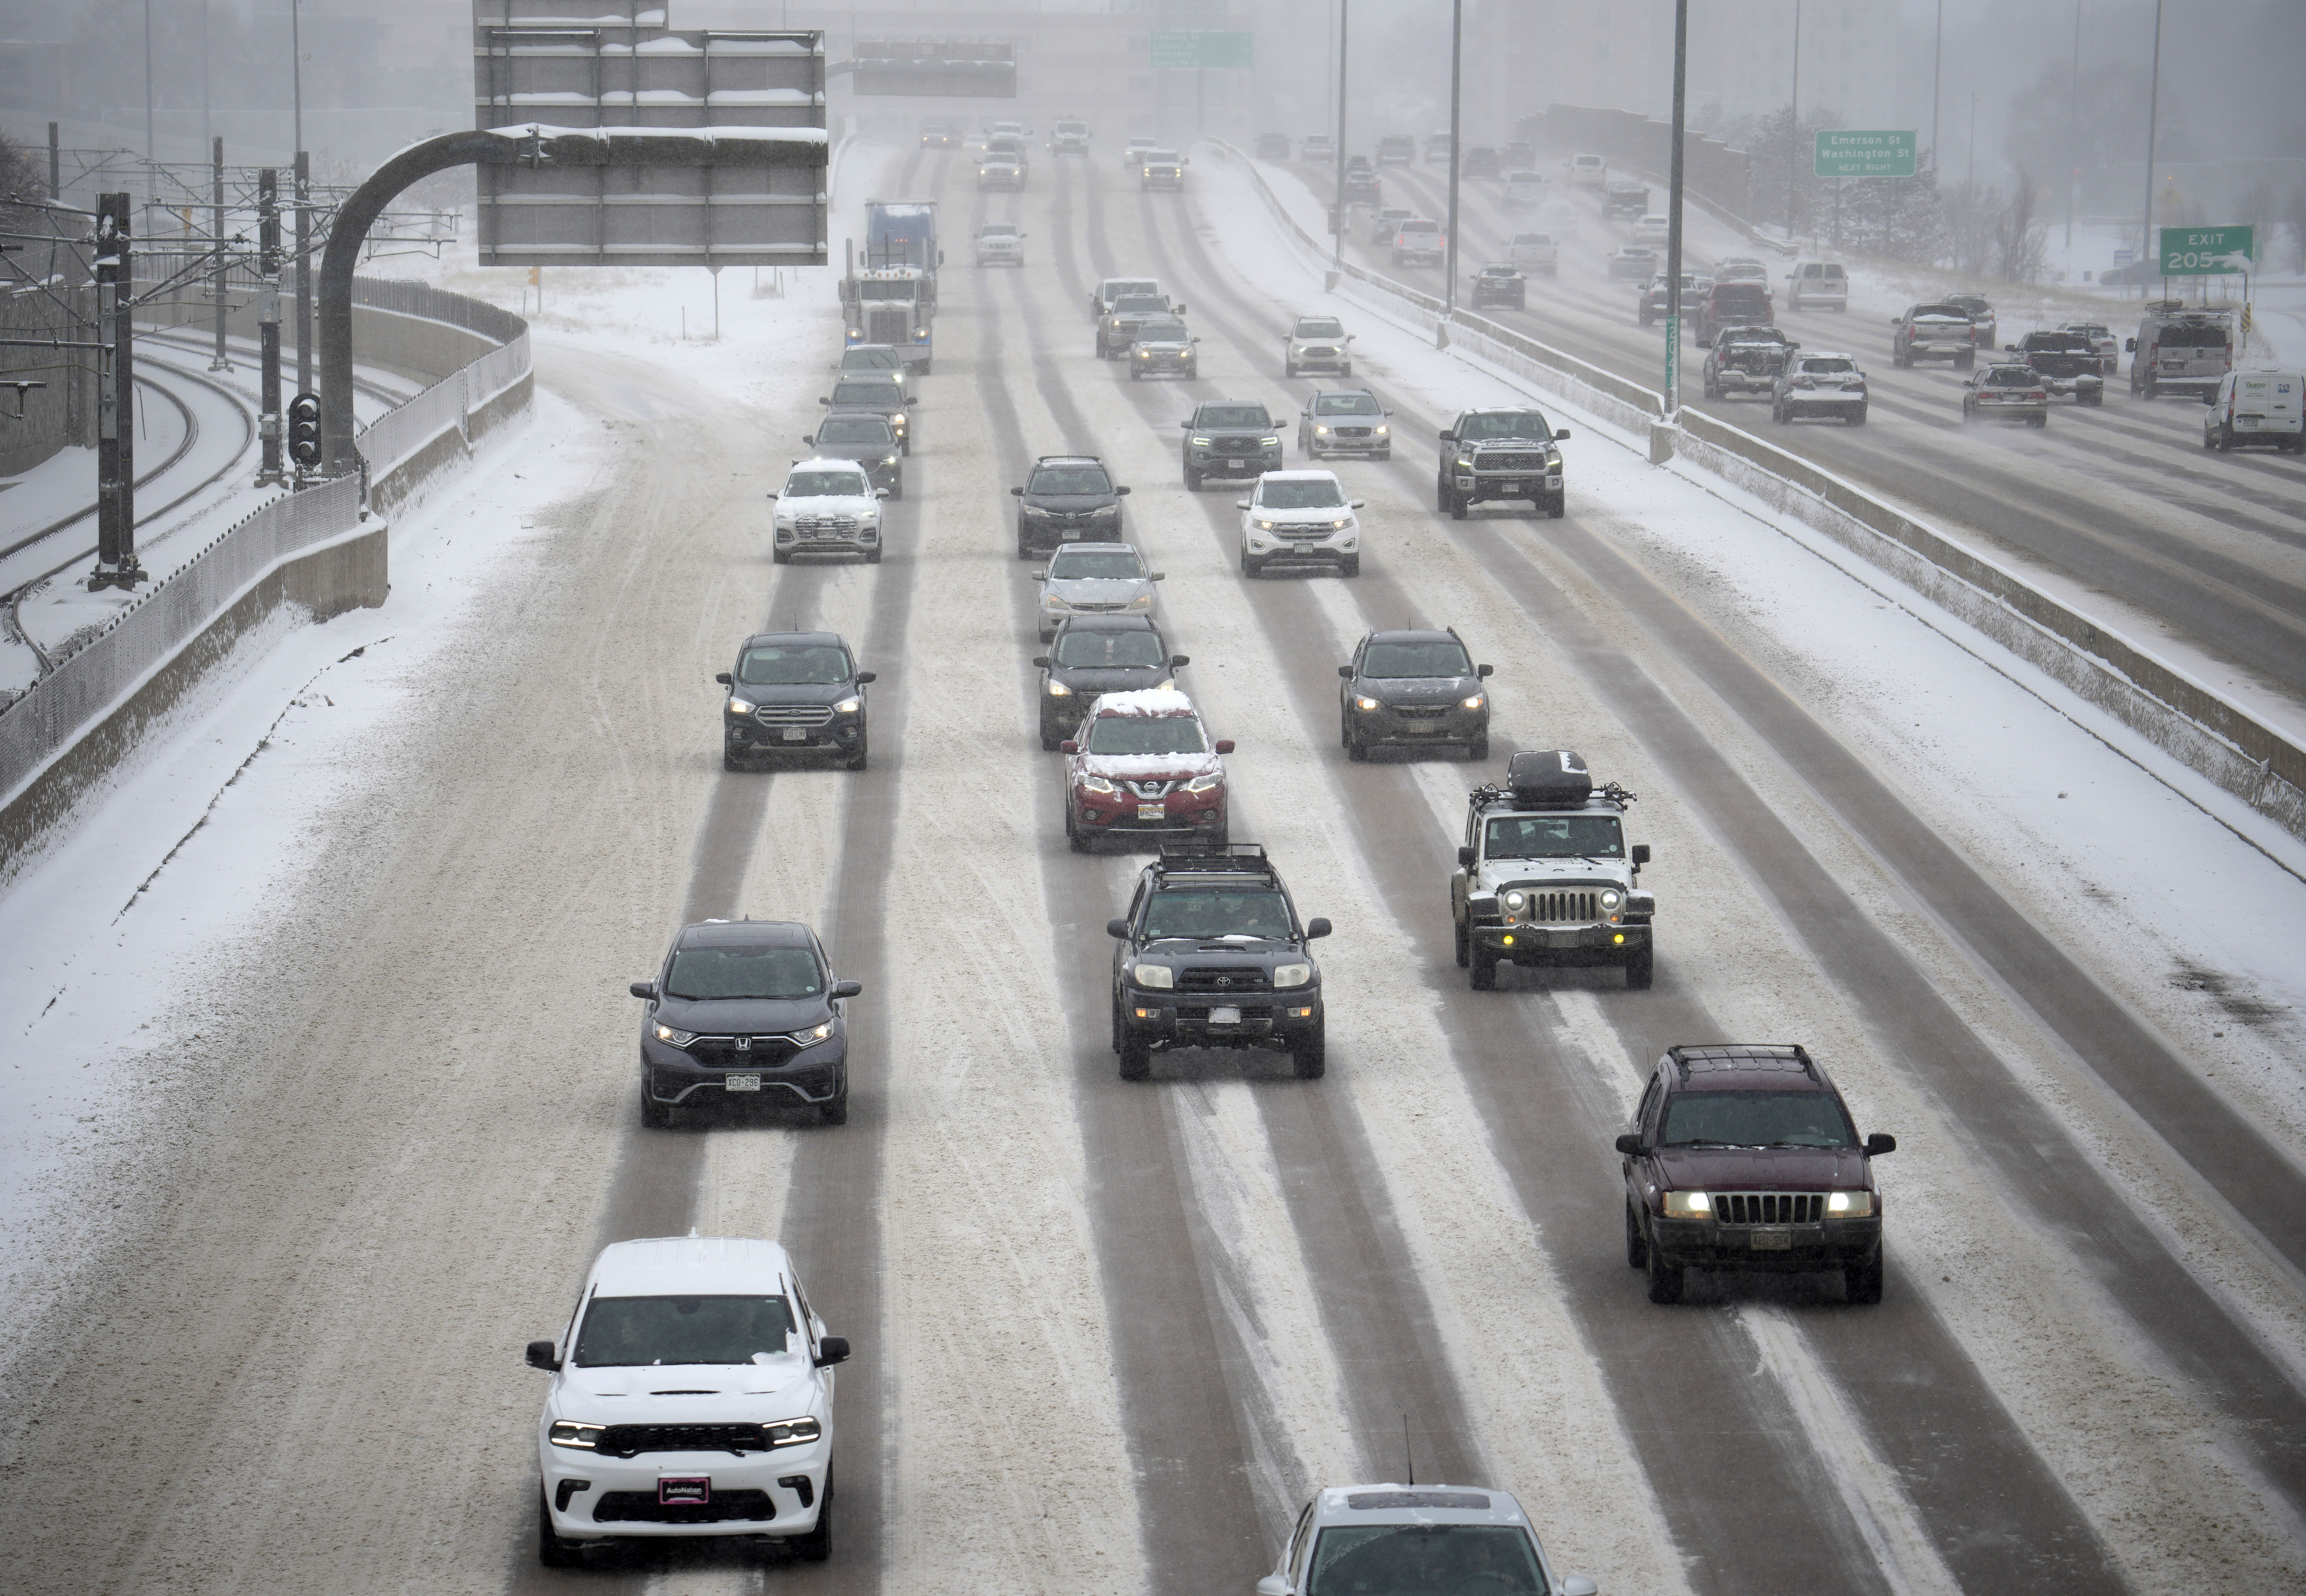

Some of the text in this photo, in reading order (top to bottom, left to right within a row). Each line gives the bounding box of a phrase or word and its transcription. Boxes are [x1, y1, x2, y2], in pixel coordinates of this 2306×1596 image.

[1831, 136, 1901, 145] Emerson St
[1822, 149, 1909, 160] Washington St
[2189, 234, 2225, 245] EXIT
[2168, 252, 2213, 269] 205
[2278, 384, 2290, 392] PPG
